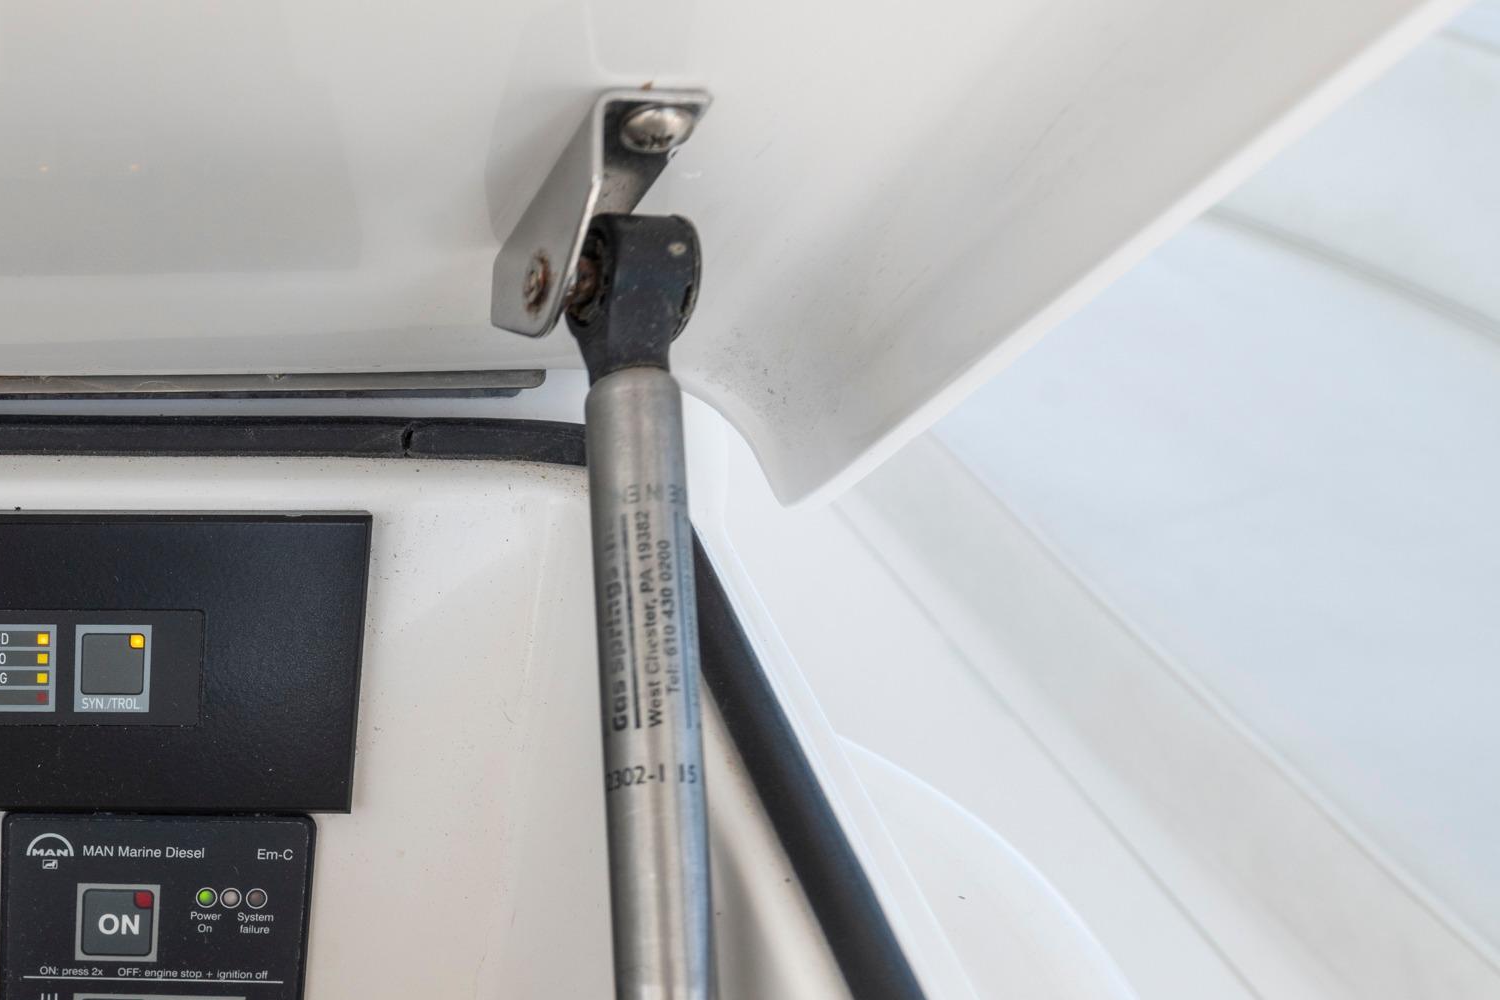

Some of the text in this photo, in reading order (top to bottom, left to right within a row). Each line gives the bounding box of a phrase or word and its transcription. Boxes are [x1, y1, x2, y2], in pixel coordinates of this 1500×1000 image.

[634, 510, 652, 562] 19382
[655, 539, 672, 582] 0200
[637, 569, 655, 594] PA
[659, 587, 675, 619] 430
[610, 680, 628, 732] Gas
[646, 681, 663, 728] West
[82, 845, 205, 859] MAN Marine Diesel
[257, 848, 294, 861] Em-C
[190, 911, 222, 922] Power
[237, 912, 274, 924] System
[98, 913, 140, 935] ON
[197, 923, 213, 934] On
[239, 924, 270, 934] failure
[39, 966, 103, 978] ON: press 2x
[117, 967, 141, 977] OFF:
[144, 969, 178, 979] engine
[180, 968, 203, 979] stop
[216, 969, 253, 980] ignition
[255, 969, 268, 979] off
